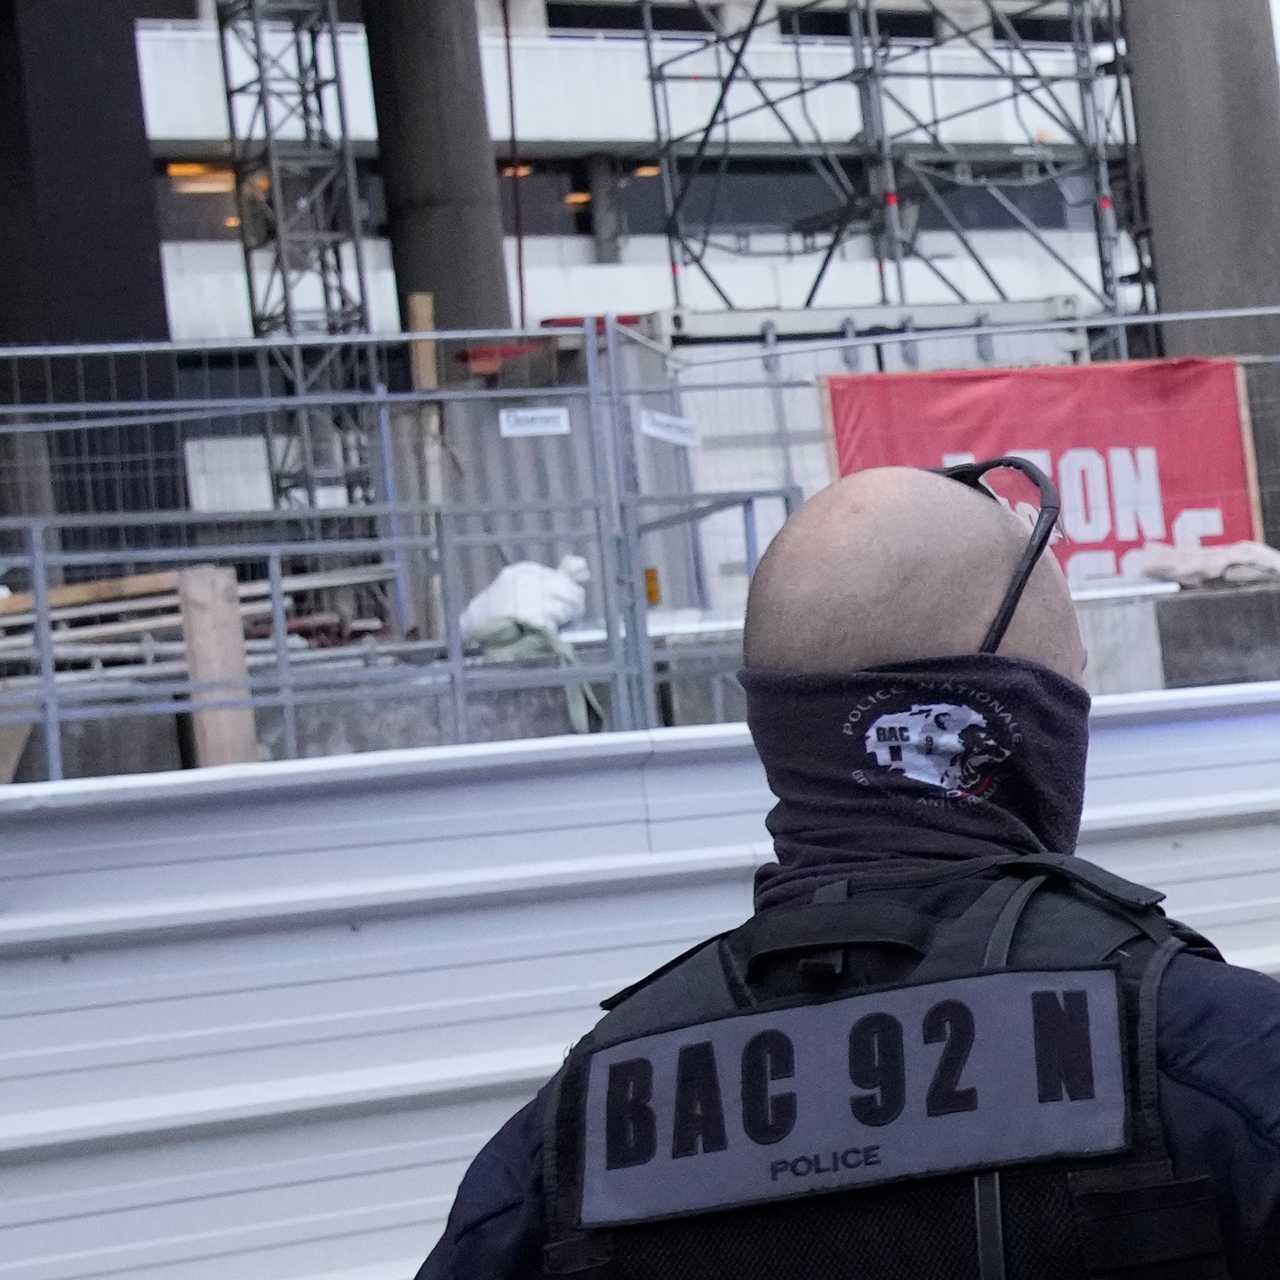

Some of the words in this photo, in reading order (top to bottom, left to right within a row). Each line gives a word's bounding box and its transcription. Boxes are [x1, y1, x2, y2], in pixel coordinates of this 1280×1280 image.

[842, 685, 906, 737] POLICE
[876, 726, 909, 743] BAC
[605, 1029, 797, 1171] BAC
[848, 999, 979, 1128] 92
[1030, 989, 1097, 1104] N
[770, 1144, 882, 1182] POLICE
